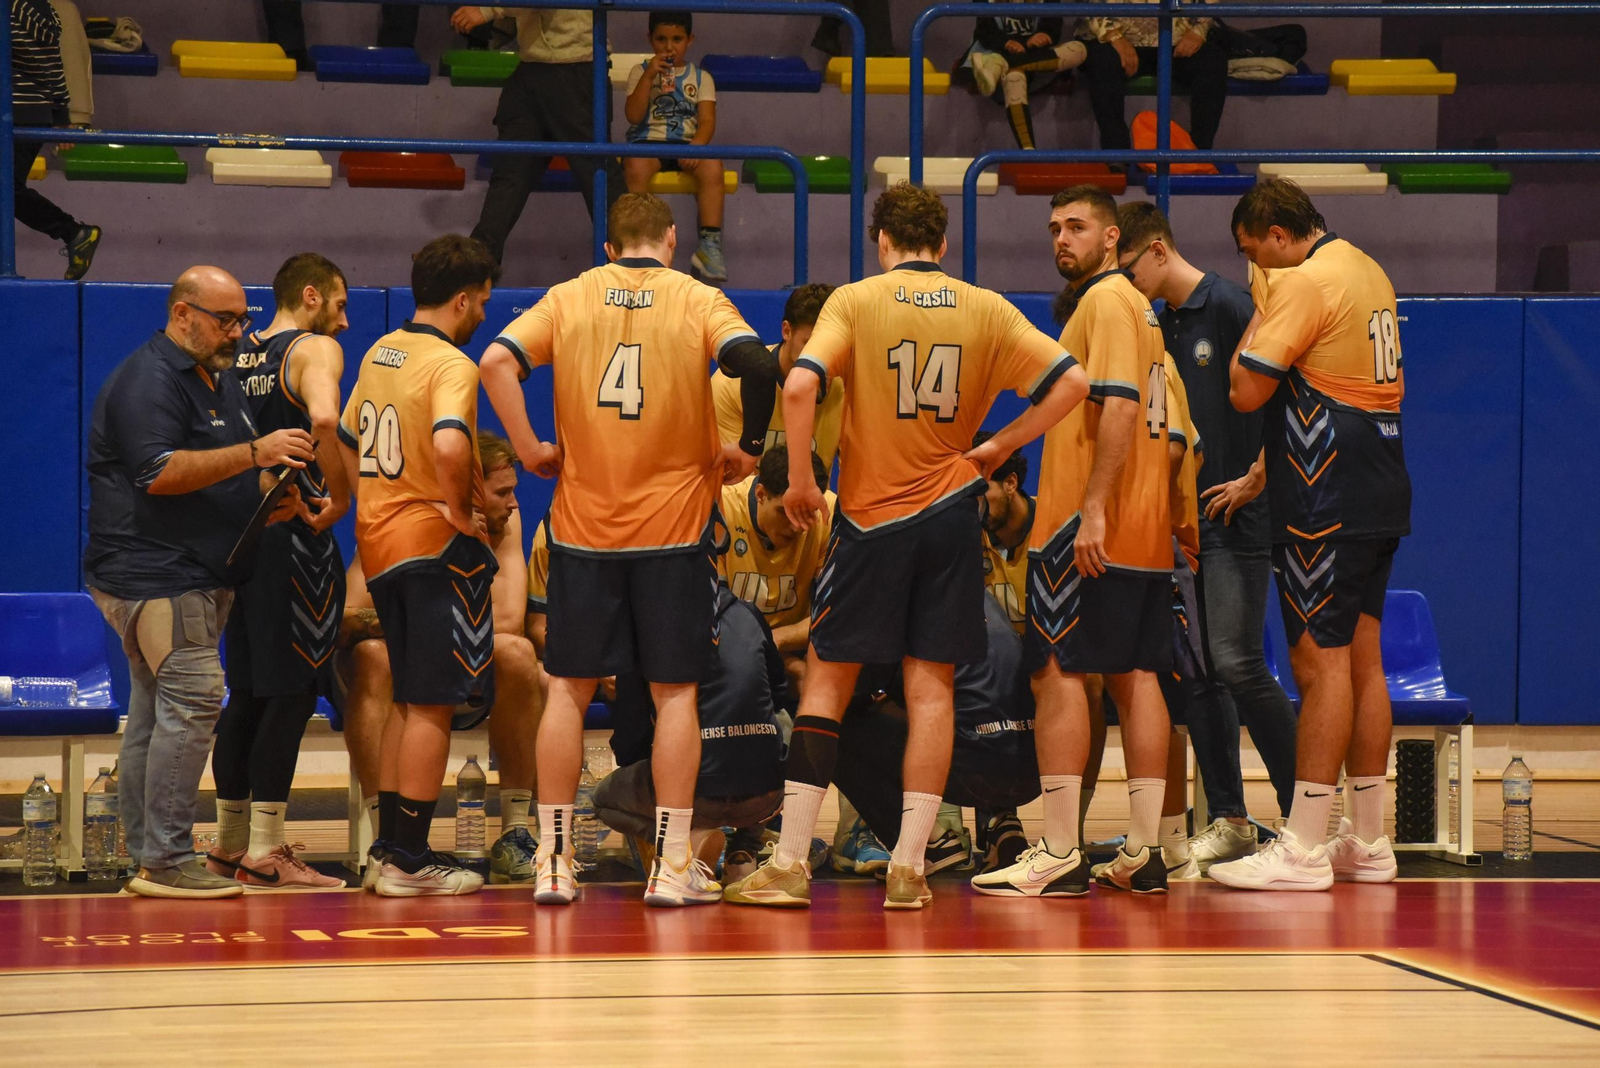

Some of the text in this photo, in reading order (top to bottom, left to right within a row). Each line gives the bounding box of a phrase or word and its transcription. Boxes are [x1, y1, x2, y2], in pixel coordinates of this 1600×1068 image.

[895, 285, 956, 308] J. CASÍN
[372, 345, 408, 369] MATEOS
[597, 342, 644, 421] 4
[887, 338, 962, 423] 14
[1368, 308, 1398, 385] 18
[359, 399, 404, 480] 20
